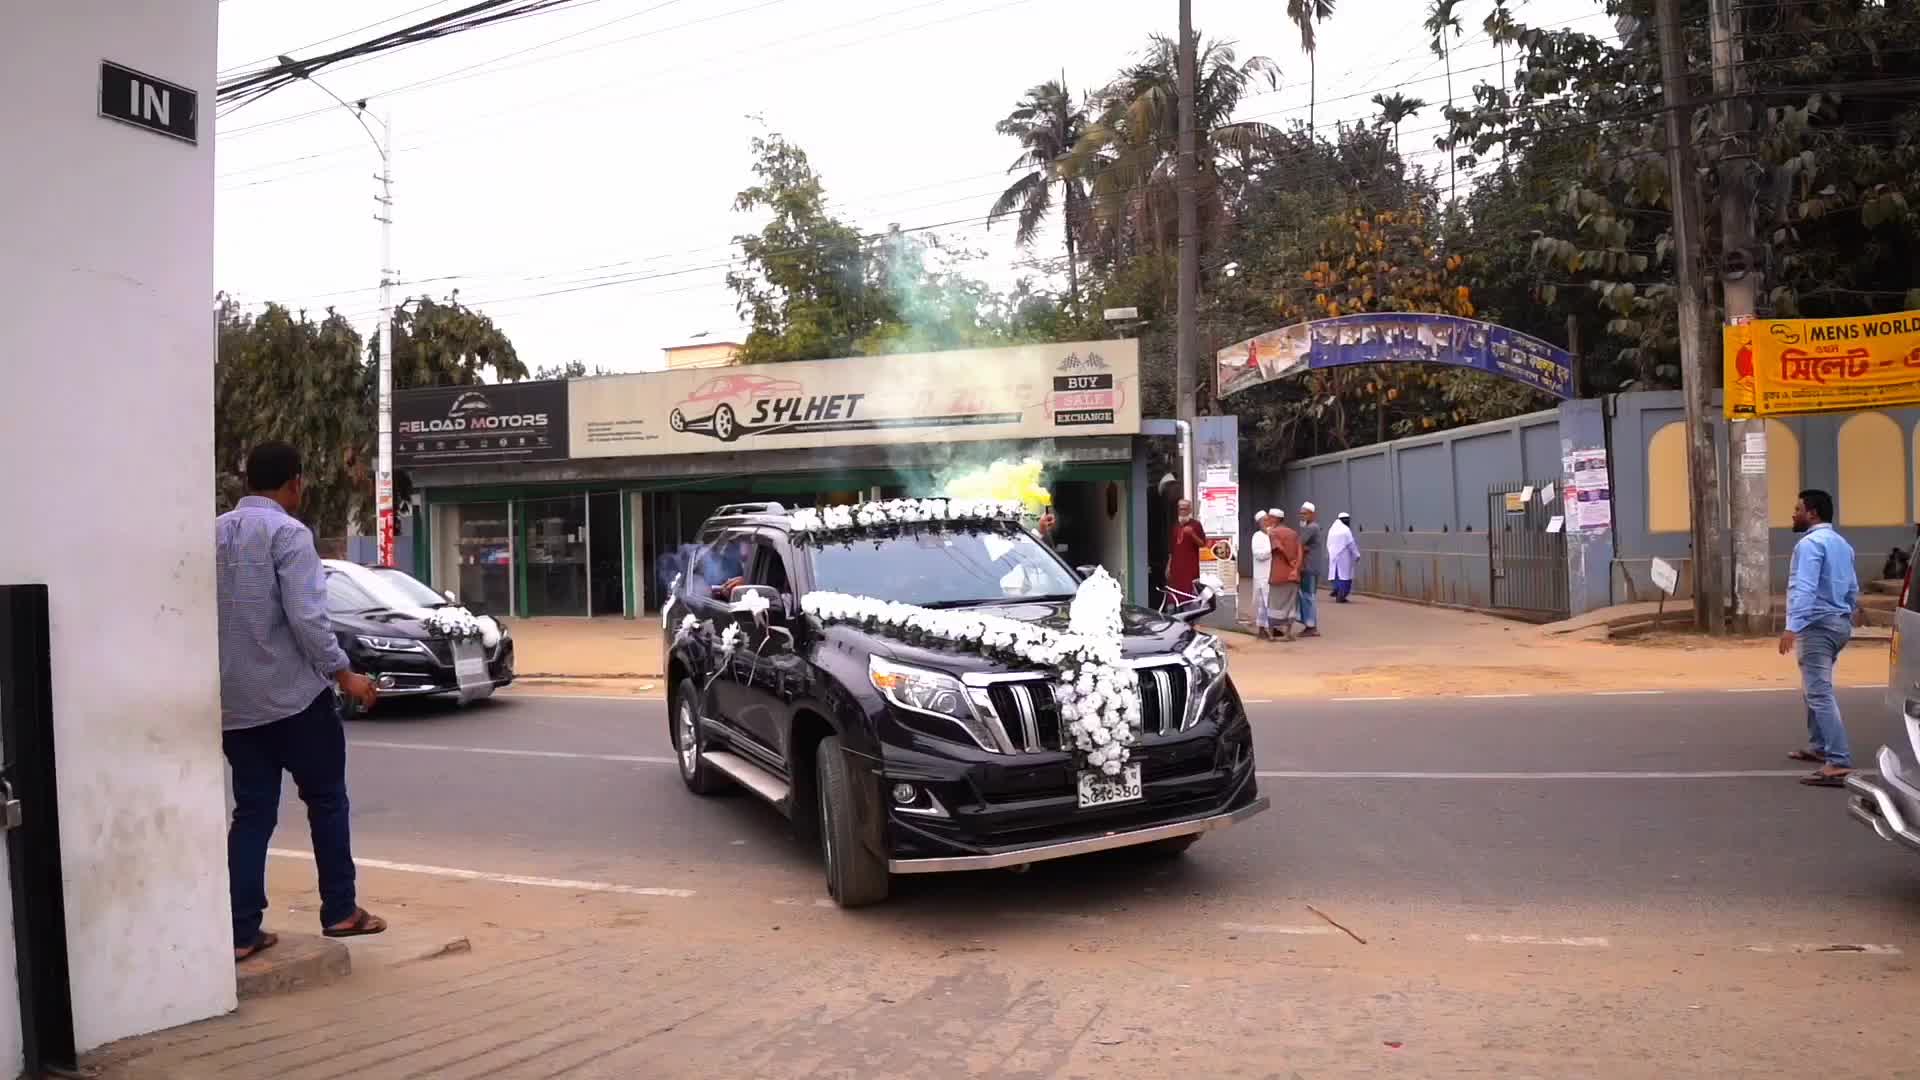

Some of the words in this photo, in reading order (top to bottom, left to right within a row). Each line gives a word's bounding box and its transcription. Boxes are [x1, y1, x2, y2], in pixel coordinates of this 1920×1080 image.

[130, 79, 170, 126] IN
[1810, 323, 1860, 342] MENS
[1862, 317, 1920, 337] WORLD
[1780, 347, 1870, 384] সিলেট
[1067, 376, 1099, 389] BUY
[751, 393, 865, 424] SYLHET
[1062, 392, 1105, 407] SALE
[399, 419, 466, 433] RELOAD
[470, 413, 549, 429] MOTORS
[1056, 412, 1113, 423] EXCHANGE
